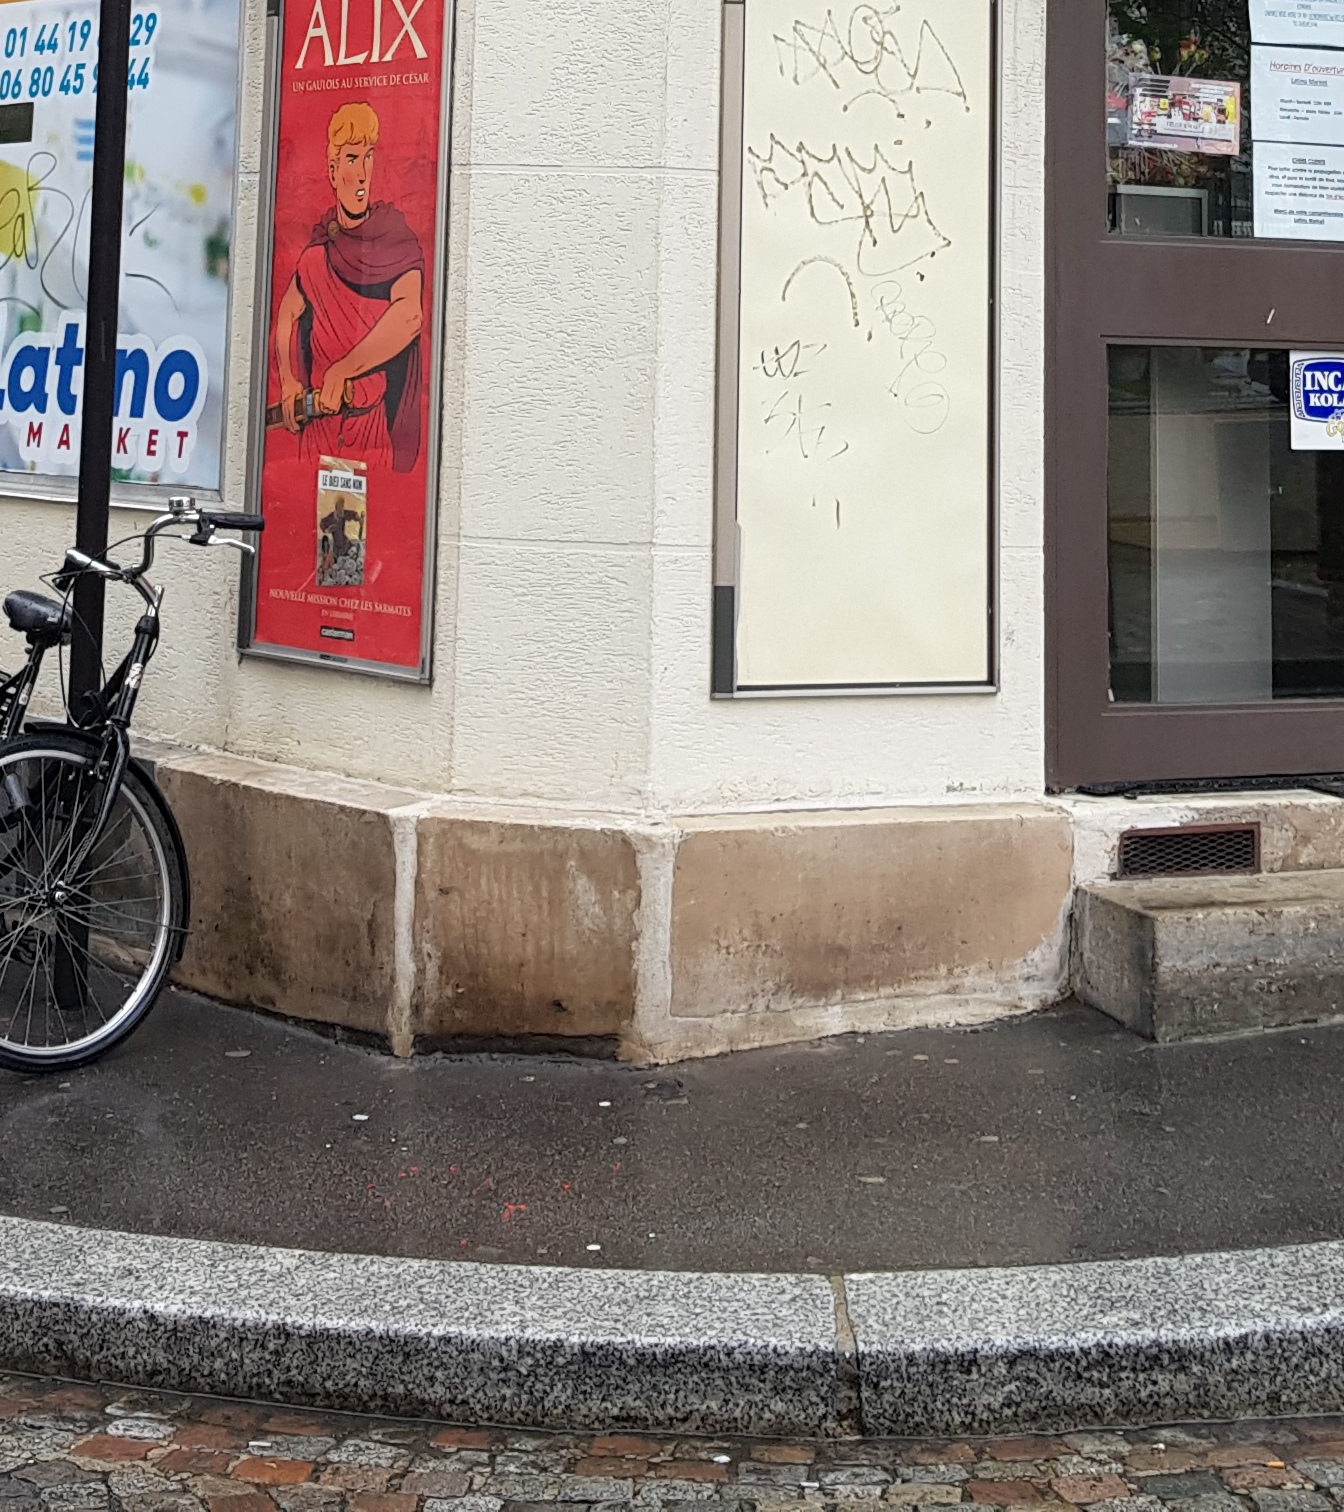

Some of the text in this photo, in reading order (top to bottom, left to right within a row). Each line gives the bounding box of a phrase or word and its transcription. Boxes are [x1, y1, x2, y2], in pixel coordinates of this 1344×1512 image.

[4, 27, 28, 59] 01
[34, 23, 59, 55] 44
[68, 19, 92, 52] 19
[129, 12, 157, 47] 29
[0, 69, 22, 100] 06
[28, 66, 54, 98] 80
[59, 63, 87, 95] 45
[292, 81, 304, 92] UN
[306, 79, 340, 92] GAULOIS
[341, 77, 353, 89] AU
[354, 75, 388, 88] SERVICE
[389, 74, 401, 86] DE
[27, 422, 189, 458] MAKET
[269, 588, 306, 603] NOUVELLE
[307, 594, 338, 606] MISSION
[339, 597, 358, 610] CHEZ
[361, 600, 372, 612] LES
